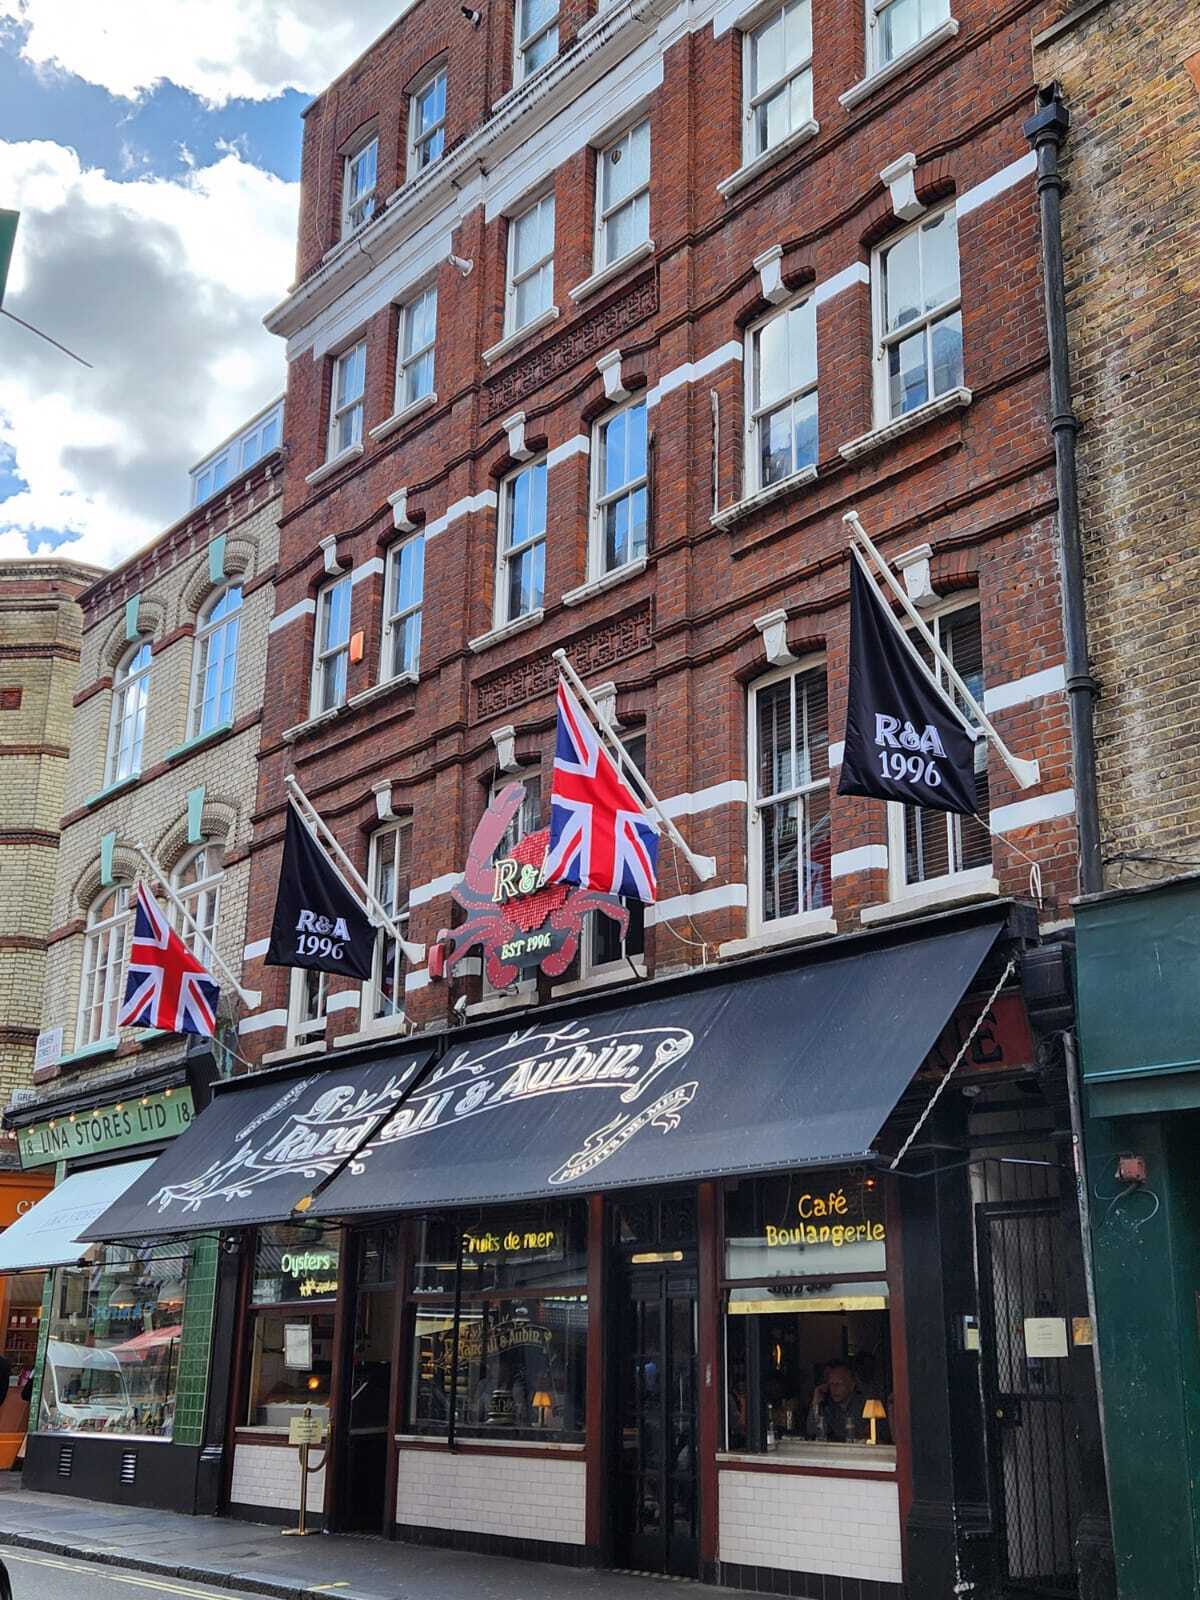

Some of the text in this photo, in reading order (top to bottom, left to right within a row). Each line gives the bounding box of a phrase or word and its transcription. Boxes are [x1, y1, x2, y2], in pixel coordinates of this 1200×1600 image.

[874, 712, 948, 759] R&A
[878, 750, 942, 788] 1996
[295, 908, 352, 942] R&A
[295, 933, 345, 960] 1996
[501, 931, 552, 961] EST 1996
[454, 1080, 496, 1116] &
[646, 1087, 687, 1119] MER
[22, 1101, 191, 1158] 18 LINA STORES LTD 18
[798, 1188, 849, 1218] Café
[503, 1230, 521, 1251] de
[281, 1251, 331, 1278] Oysters
